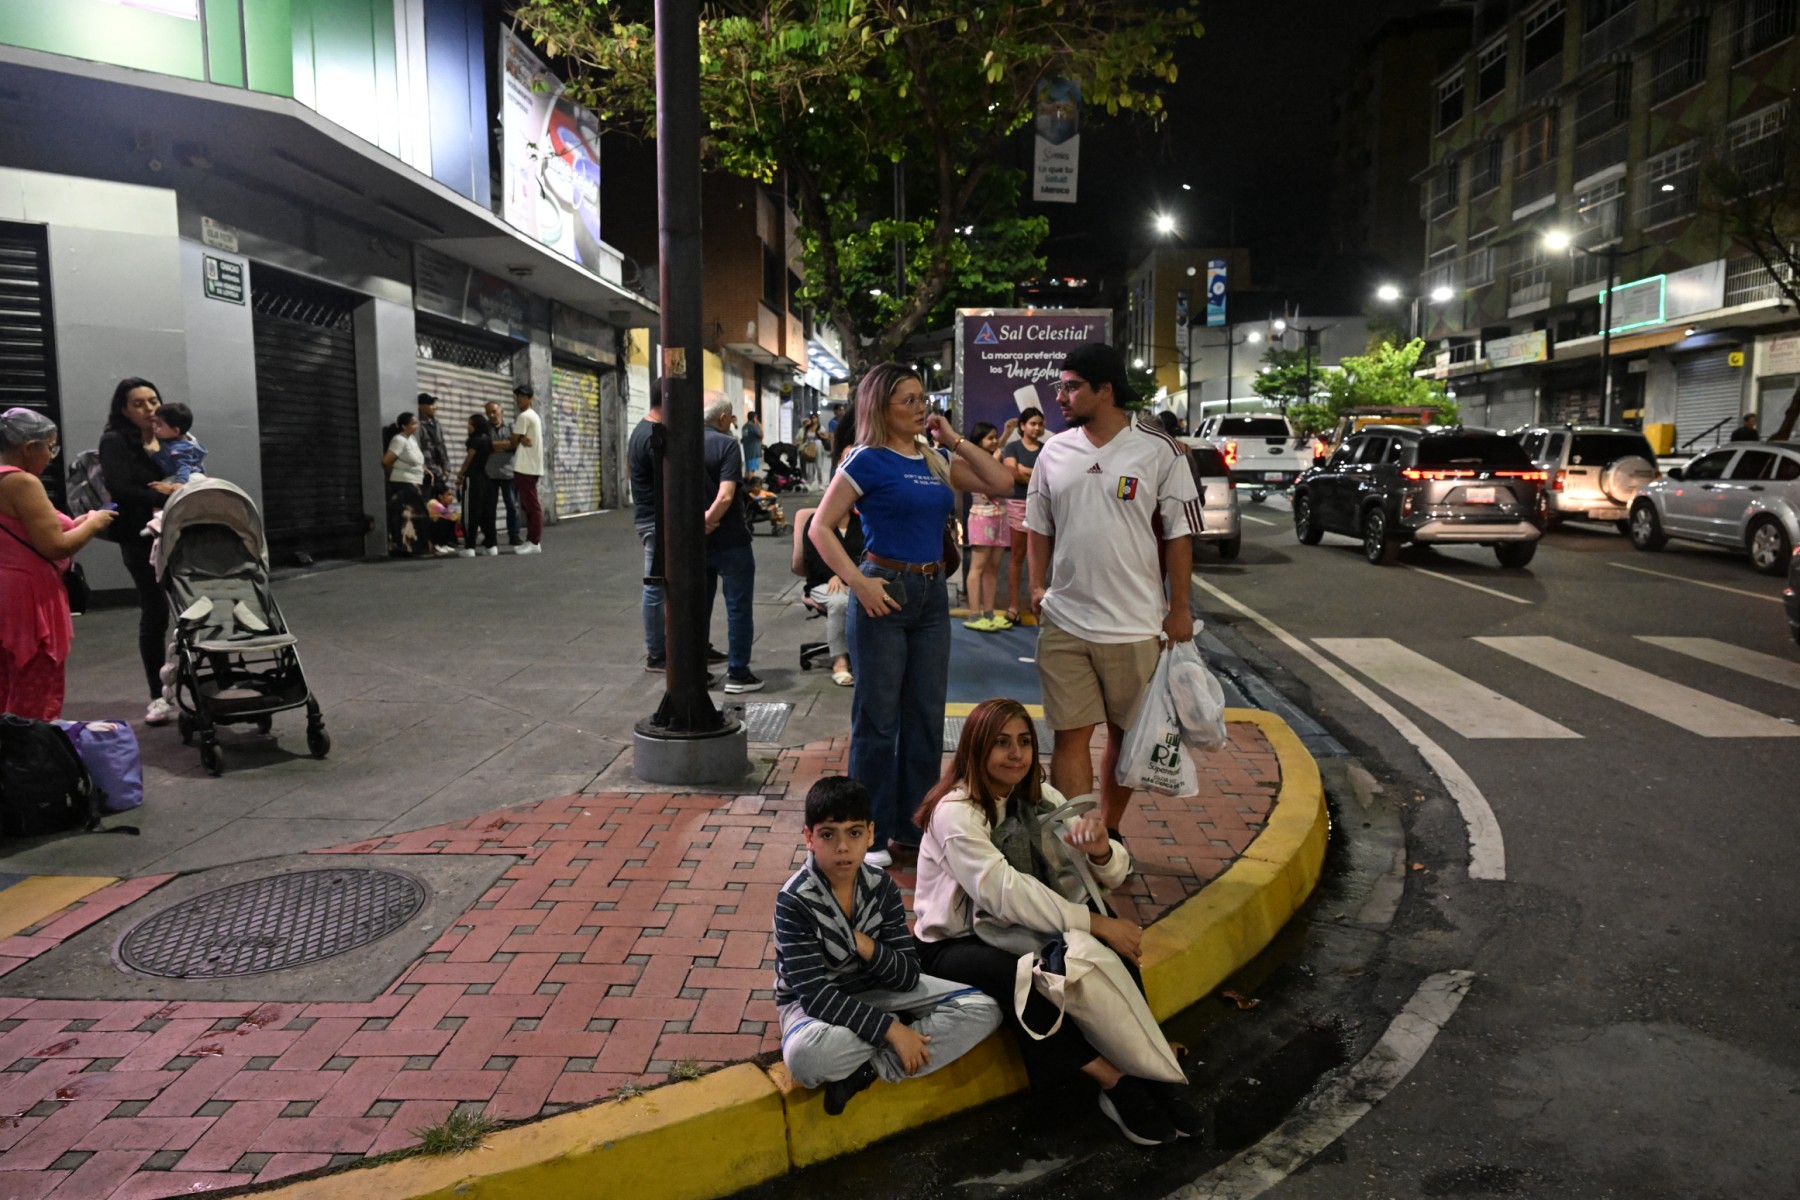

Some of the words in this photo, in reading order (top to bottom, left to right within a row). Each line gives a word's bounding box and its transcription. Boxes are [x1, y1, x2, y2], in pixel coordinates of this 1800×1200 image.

[1048, 166, 1064, 175] que
[1000, 325, 1023, 340] Sal
[1026, 325, 1088, 340] Celestial
[982, 352, 994, 360] La
[990, 366, 1002, 374] los
[1004, 361, 1062, 383] Venezolan
